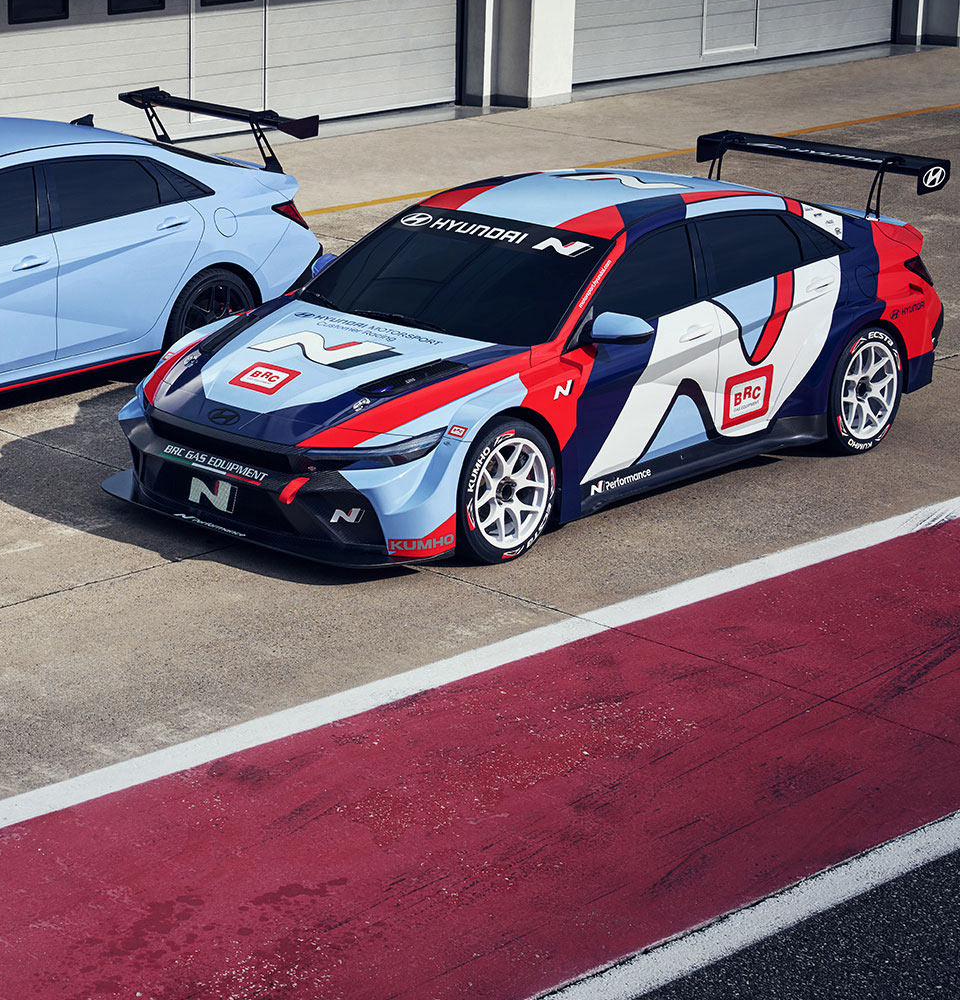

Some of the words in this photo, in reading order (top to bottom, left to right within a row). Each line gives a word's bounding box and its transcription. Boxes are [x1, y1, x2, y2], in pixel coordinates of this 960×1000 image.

[430, 217, 529, 244] HYUNDAI
[531, 237, 594, 257] N
[313, 314, 368, 329] HYUNDAI
[368, 325, 444, 346] MOTORSPORT
[316, 321, 363, 333] Customer
[363, 330, 397, 343] Racing
[247, 331, 403, 370] N
[250, 370, 280, 382] BRC
[553, 379, 575, 400] N
[734, 385, 761, 407] BRC
[847, 438, 873, 450] KUMHO
[163, 444, 186, 457] BRC
[185, 450, 208, 463] GAS
[207, 456, 268, 481] EQUIPMENT
[467, 446, 491, 492] KUMHO
[590, 480, 605, 496] N
[605, 468, 652, 491] Performance
[188, 477, 238, 514] N
[329, 508, 365, 523] N
[390, 534, 454, 551] KUMHO
